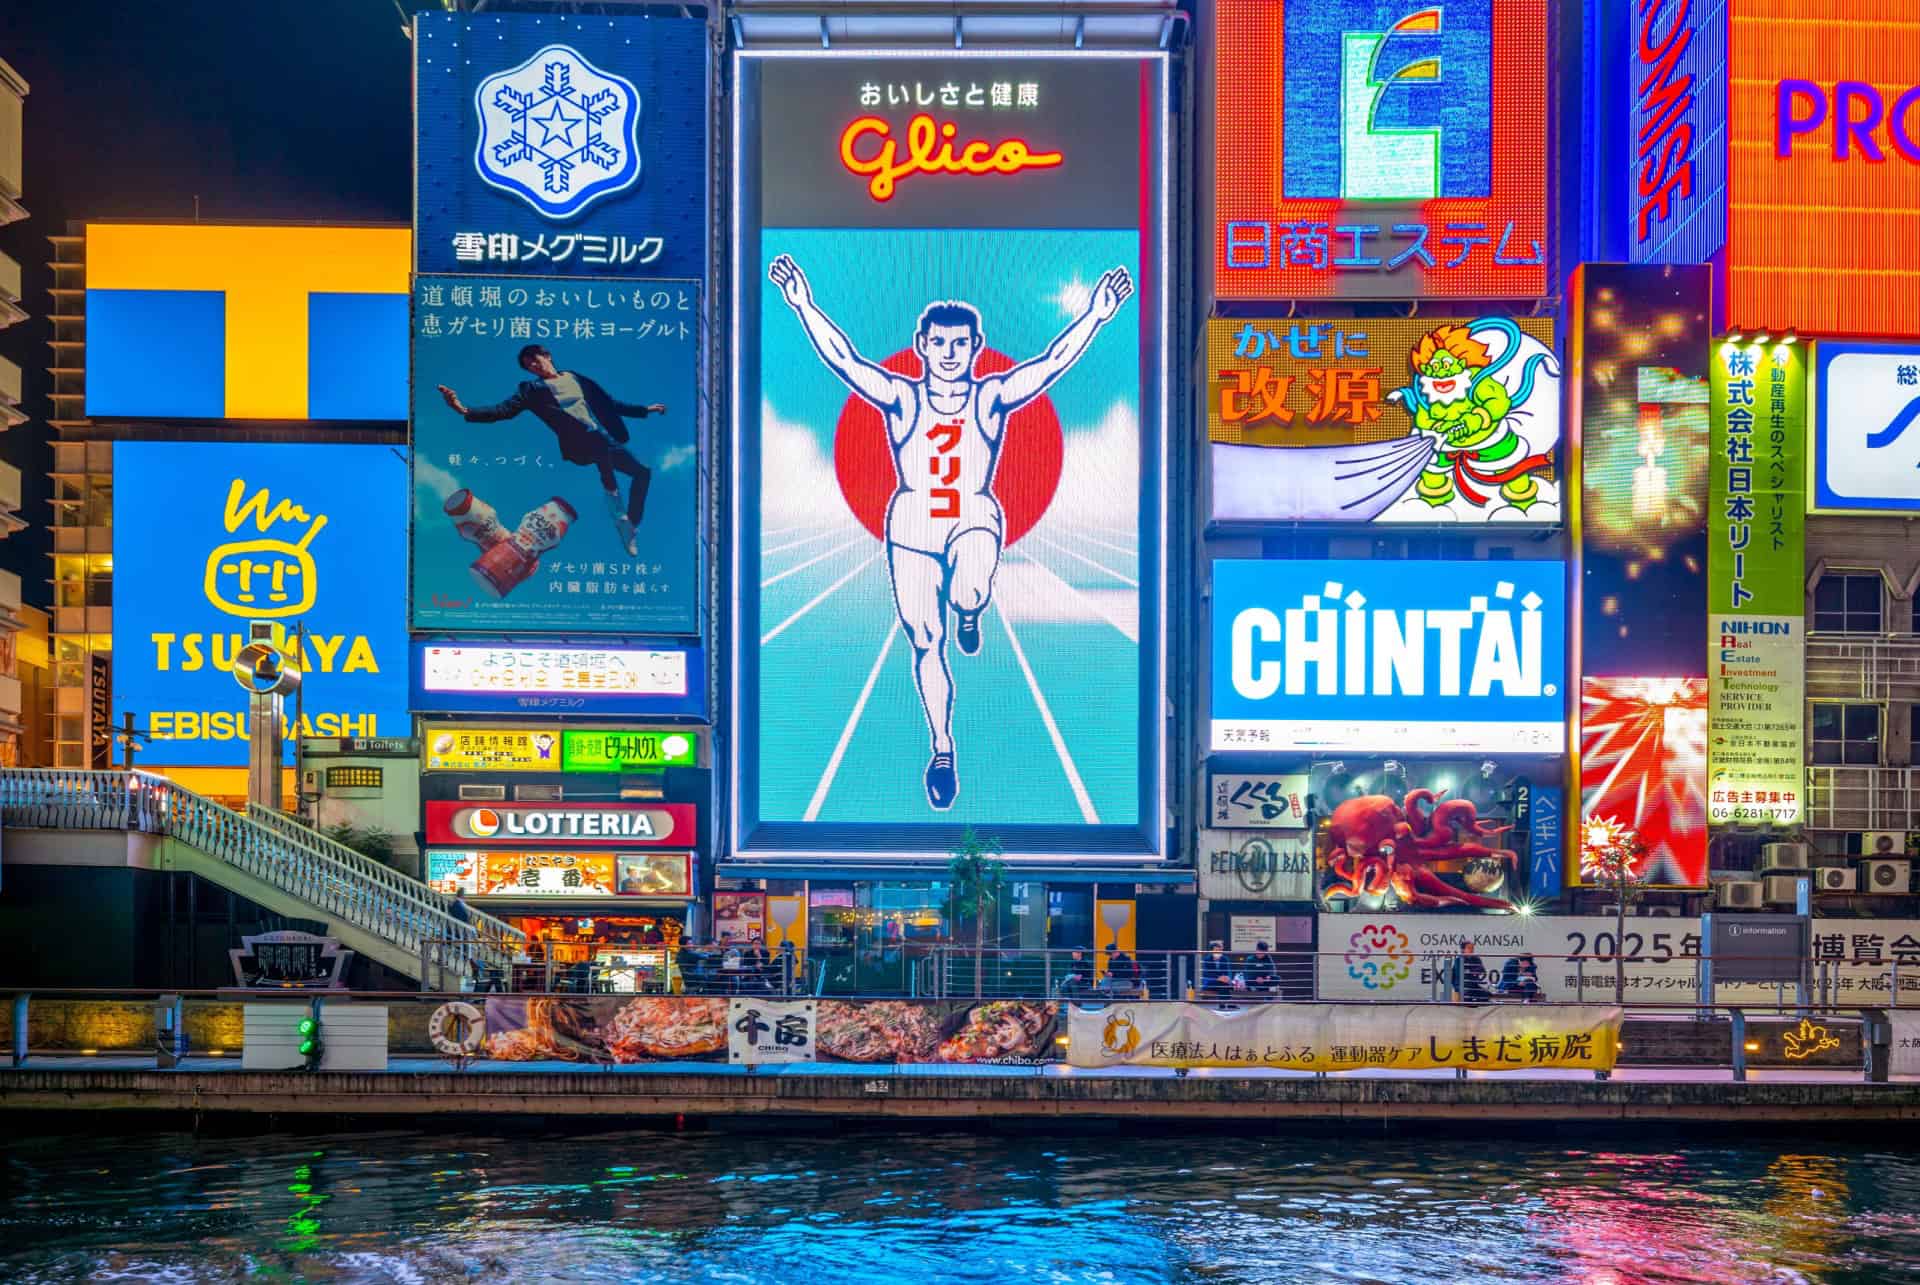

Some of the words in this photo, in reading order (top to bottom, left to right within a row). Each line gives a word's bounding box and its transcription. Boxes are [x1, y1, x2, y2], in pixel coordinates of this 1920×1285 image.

[860, 82, 1039, 107] おいしさと健康
[840, 114, 1063, 201] Glico
[453, 232, 664, 264] 雪印メグミルク
[1226, 220, 1544, 270] 日商エステム
[421, 284, 690, 311] 道頓堀のおいしいものと
[1233, 323, 1370, 360] かぜに
[1218, 366, 1384, 425] 改源
[1769, 353, 1786, 551] 不動産再生のスペシャリスト
[926, 417, 965, 519] グリコ
[1726, 350, 1754, 608] 株式会社日本リート
[550, 561, 662, 576] ガセリ菌SP株が
[1231, 581, 1543, 700] CHINTAI
[1721, 621, 1790, 635] NIHON
[151, 632, 381, 674] TSUAYA
[1720, 635, 1752, 649] Real
[1720, 649, 1760, 663] Estate
[1720, 664, 1777, 677] Investment
[1720, 677, 1779, 692] Technology
[1720, 692, 1762, 701] SERVICE
[93, 664, 107, 746] TSUTAYA
[1720, 702, 1772, 711] PROVIDER
[370, 740, 402, 750] Toilets
[1230, 781, 1289, 820] くくる
[1712, 790, 1796, 804] 広告主募集中
[507, 813, 654, 836] LOTTERIA
[1712, 808, 1797, 819] 06-6281-1717
[1474, 935, 1524, 947] KANSAI
[1743, 924, 1787, 935] information
[1151, 1040, 1315, 1063] 医療法人はぁとふる
[1330, 1043, 1423, 1064] 運動器ケア
[1430, 1034, 1593, 1063] しまだ病院
